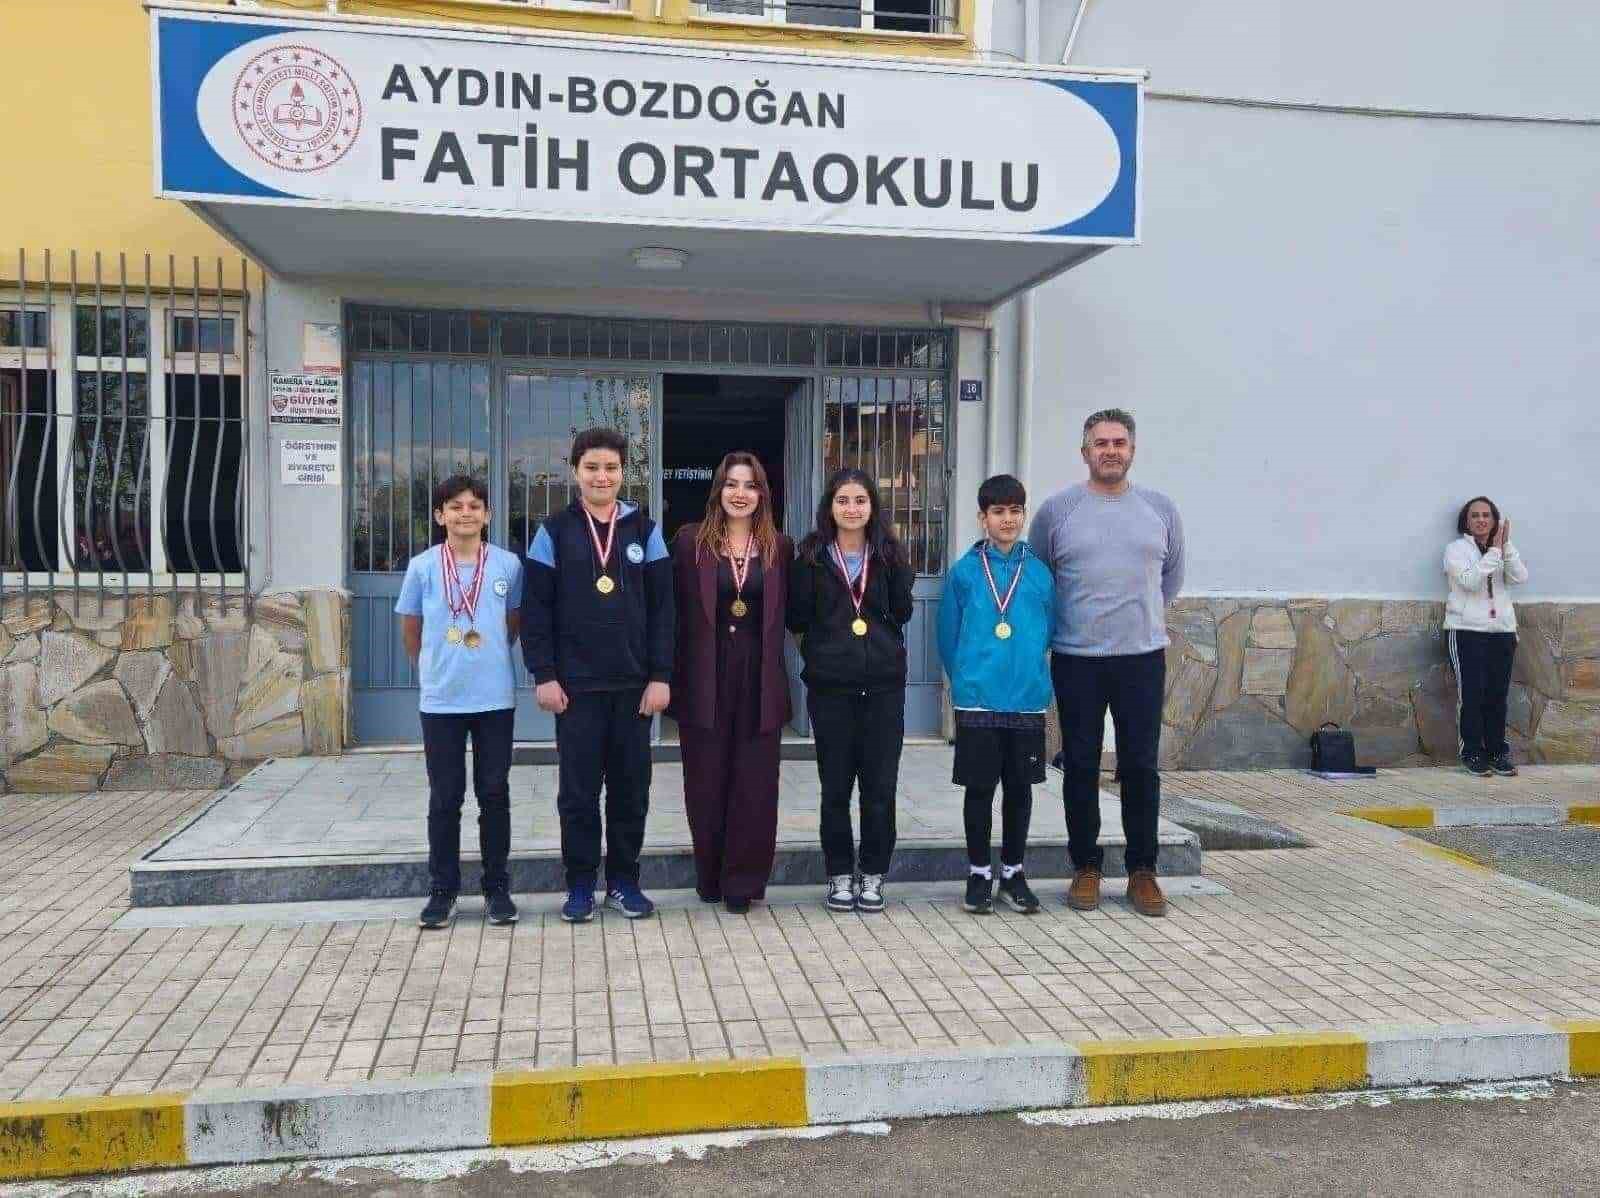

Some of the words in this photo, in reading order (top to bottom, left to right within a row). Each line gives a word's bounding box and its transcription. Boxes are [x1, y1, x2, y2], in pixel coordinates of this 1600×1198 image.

[382, 64, 846, 129] AYDIN-BOZDOĞAN
[382, 123, 589, 192] FATİH
[617, 142, 1039, 213] ORTAOKULU
[272, 377, 303, 385] KAMERA
[289, 393, 325, 406] GÜVEN
[305, 453, 318, 461] VE
